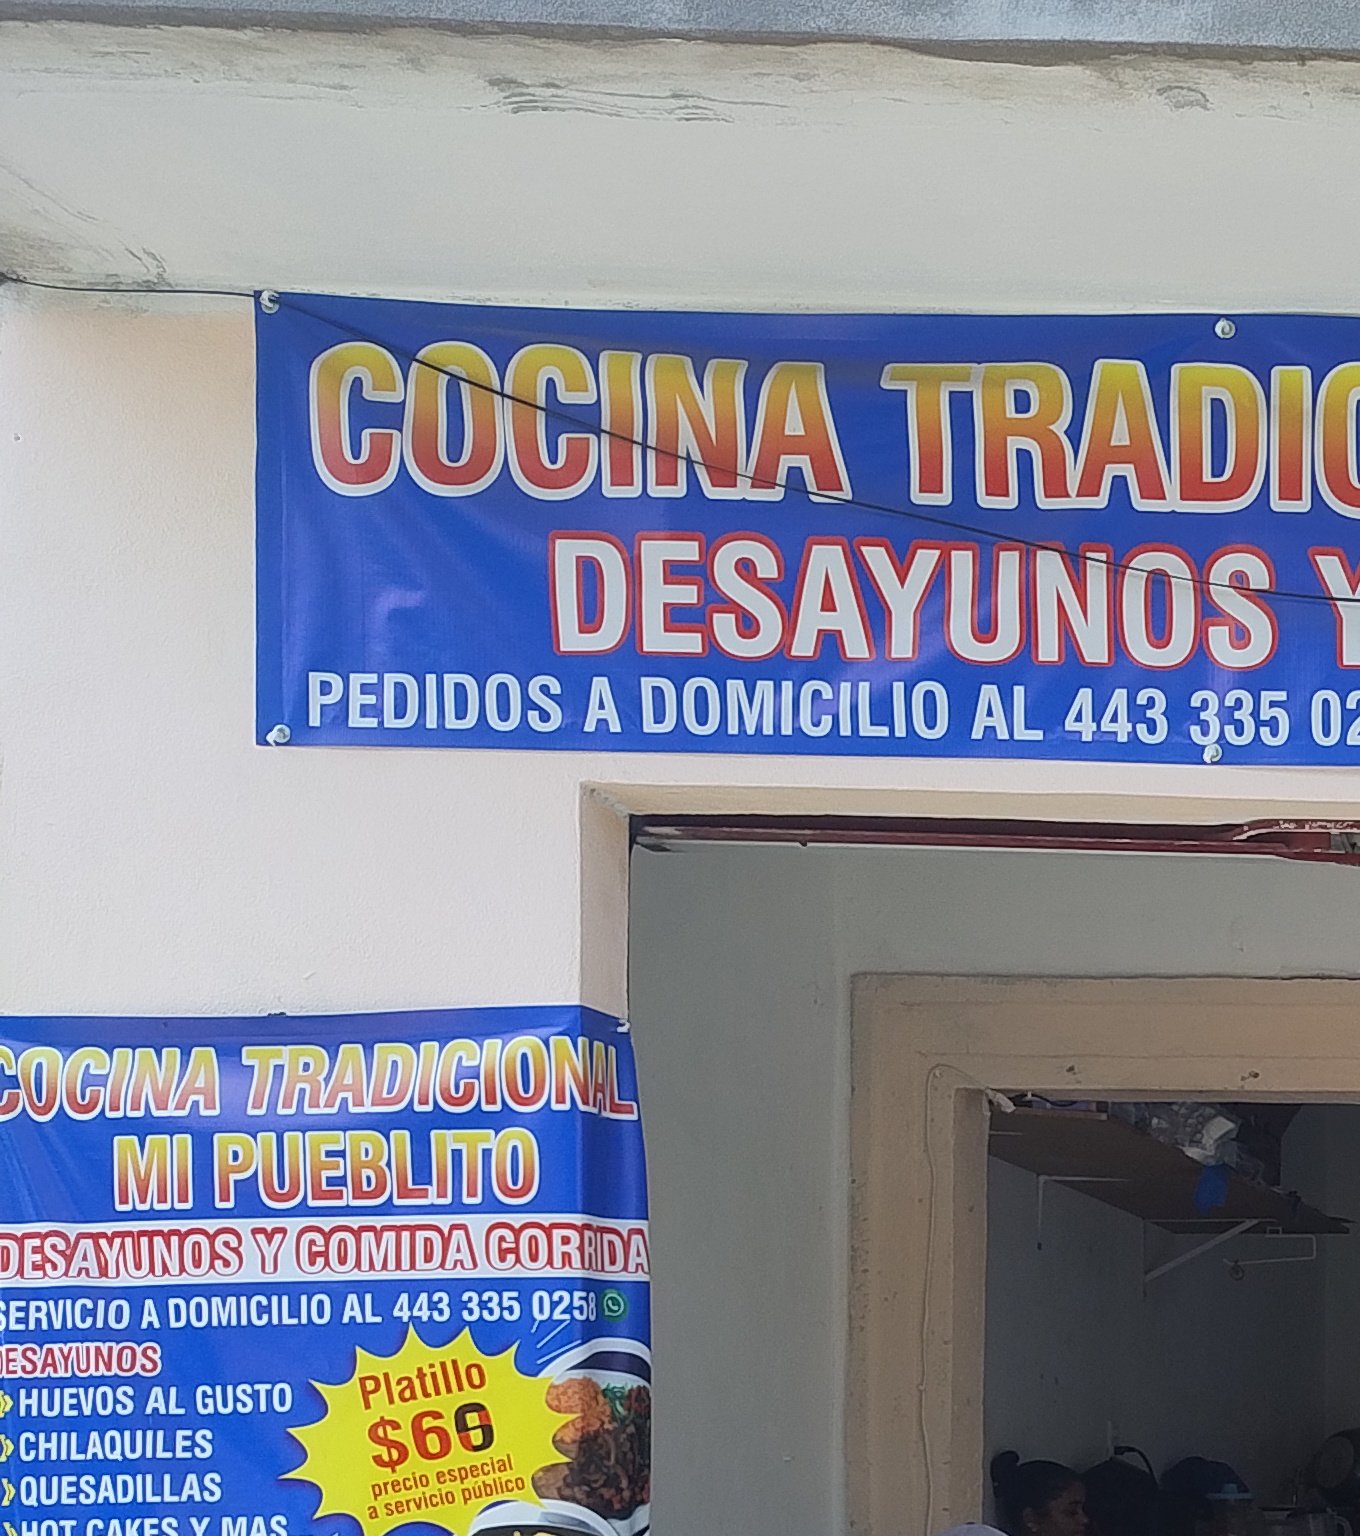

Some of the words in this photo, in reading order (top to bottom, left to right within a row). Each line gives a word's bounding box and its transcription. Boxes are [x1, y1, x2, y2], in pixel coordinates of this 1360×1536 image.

[309, 341, 851, 502] COCINA
[549, 531, 1279, 670] DESAYUNOS
[307, 671, 563, 732] PEDIDOS
[583, 676, 623, 734] A
[641, 676, 950, 739] DOMICILIO
[970, 684, 1044, 742] AL
[1063, 688, 1169, 745] 443
[1190, 690, 1290, 747] 335
[0, 1044, 219, 1122] COCINA
[241, 1036, 639, 1122] TRADICIONAL
[113, 1133, 193, 1211] MI
[212, 1127, 540, 1210] PUEBLITO
[0, 1231, 243, 1280] DESAYUNOS
[253, 1226, 287, 1275] Y
[295, 1224, 475, 1275] COMIDA
[485, 1222, 649, 1275] CORRIDA
[140, 1297, 161, 1329] A
[169, 1293, 331, 1328] DOMICILIO
[342, 1292, 383, 1324] AL
[393, 1291, 450, 1323] 443
[461, 1290, 521, 1322] 335
[532, 1289, 597, 1321] 0258
[0, 1342, 161, 1377] ESAYUNOS
[358, 1358, 486, 1411] Platillo
[19, 1385, 134, 1417] HUEVOS
[145, 1386, 186, 1416] AL
[195, 1383, 293, 1415] GUSTO
[19, 1429, 213, 1461] CHILAQUILES
[20, 1473, 222, 1507] QUESADILLAS
[367, 1503, 379, 1519] a
[384, 1490, 456, 1517] servicio
[462, 1475, 526, 1505] público
[371, 1473, 430, 1502] precio
[436, 1454, 513, 1488] especial
